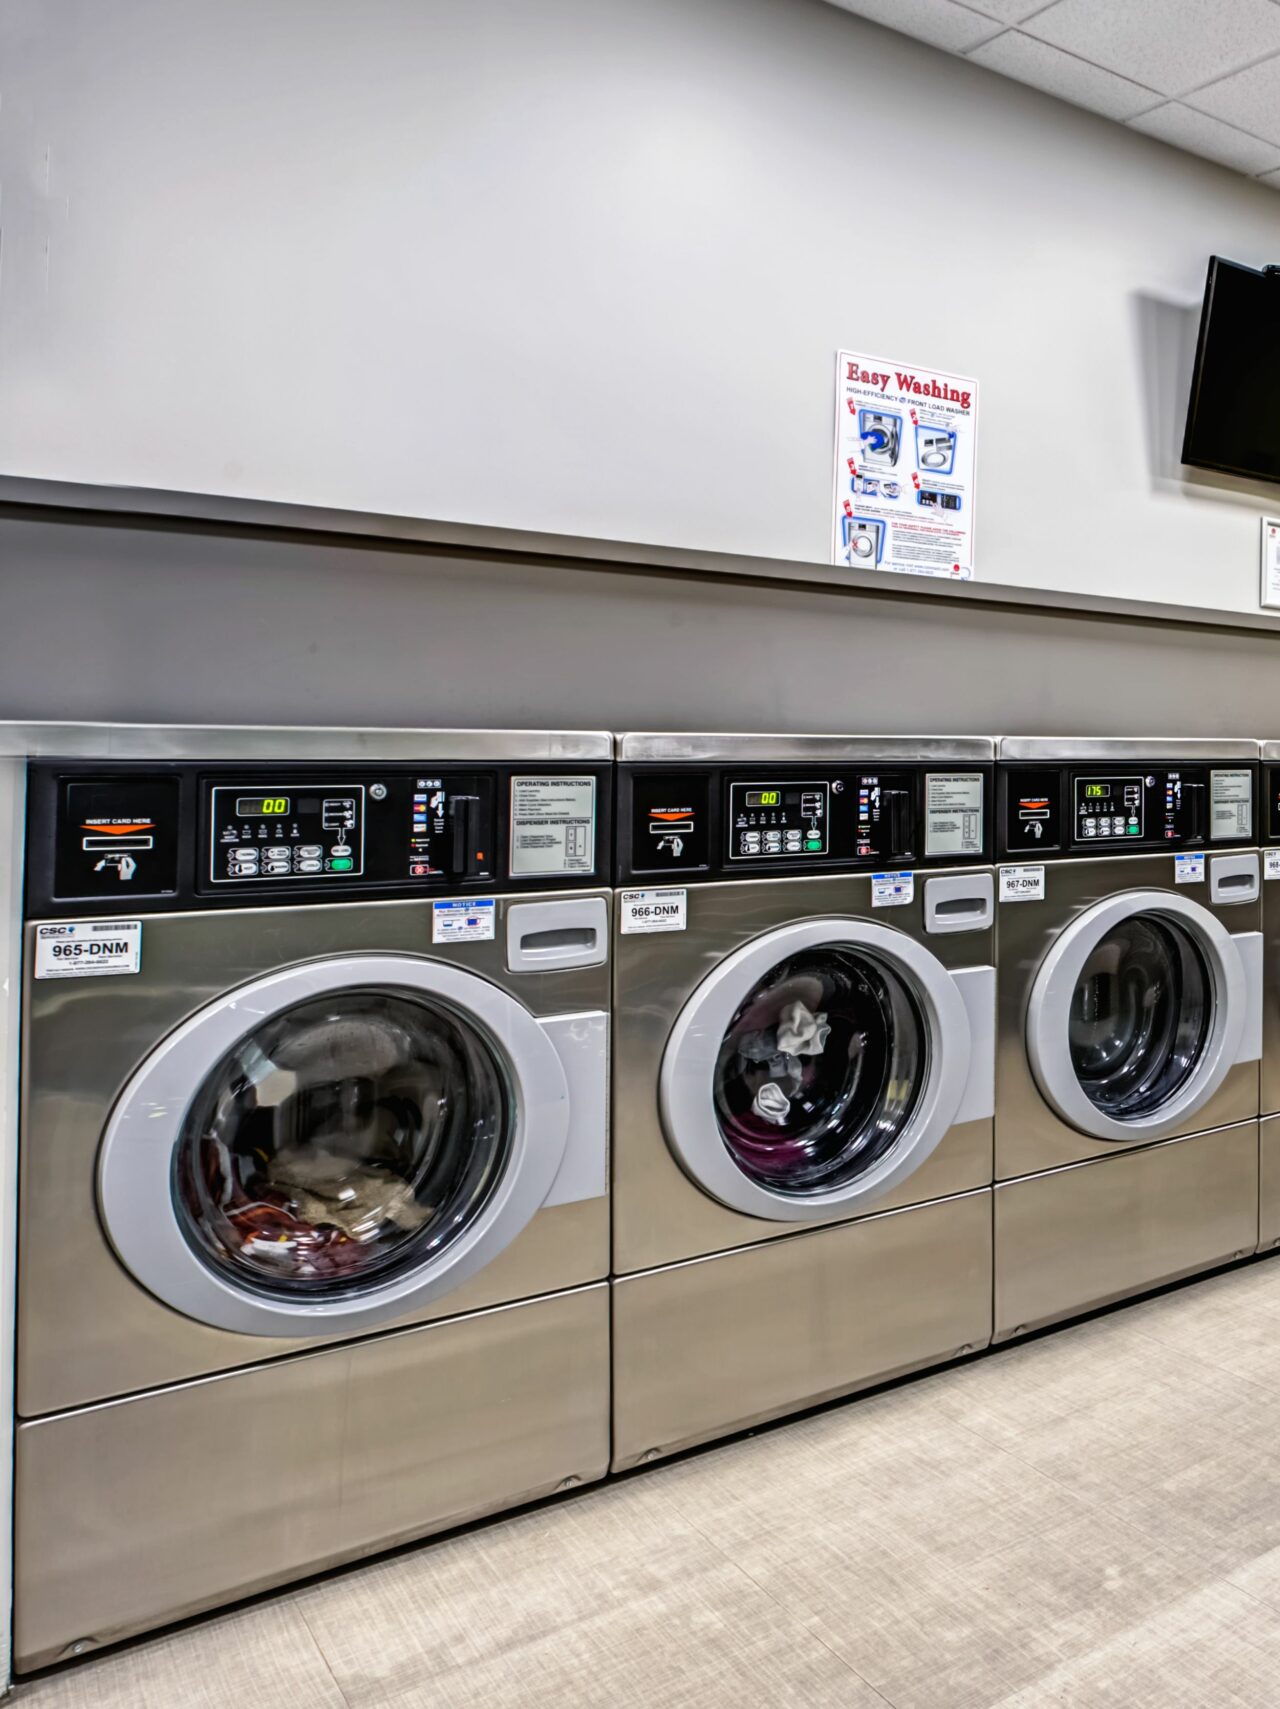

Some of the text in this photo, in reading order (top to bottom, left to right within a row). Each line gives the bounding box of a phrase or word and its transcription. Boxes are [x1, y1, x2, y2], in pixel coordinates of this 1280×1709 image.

[846, 362, 891, 393] Easy
[894, 372, 971, 409] Washing
[846, 386, 898, 402] HIGH-EFFICIENCY
[907, 398, 928, 408] FRONT
[928, 403, 945, 411] LOAD
[945, 407, 971, 416] WASHER
[1088, 786, 1102, 796] 175
[761, 792, 777, 804] 00
[262, 799, 286, 813] 00
[1006, 879, 1040, 889] 967-DNM
[631, 905, 679, 917] 966-DNM
[39, 927, 67, 935] CSC
[52, 942, 128, 957] 965-DNM
